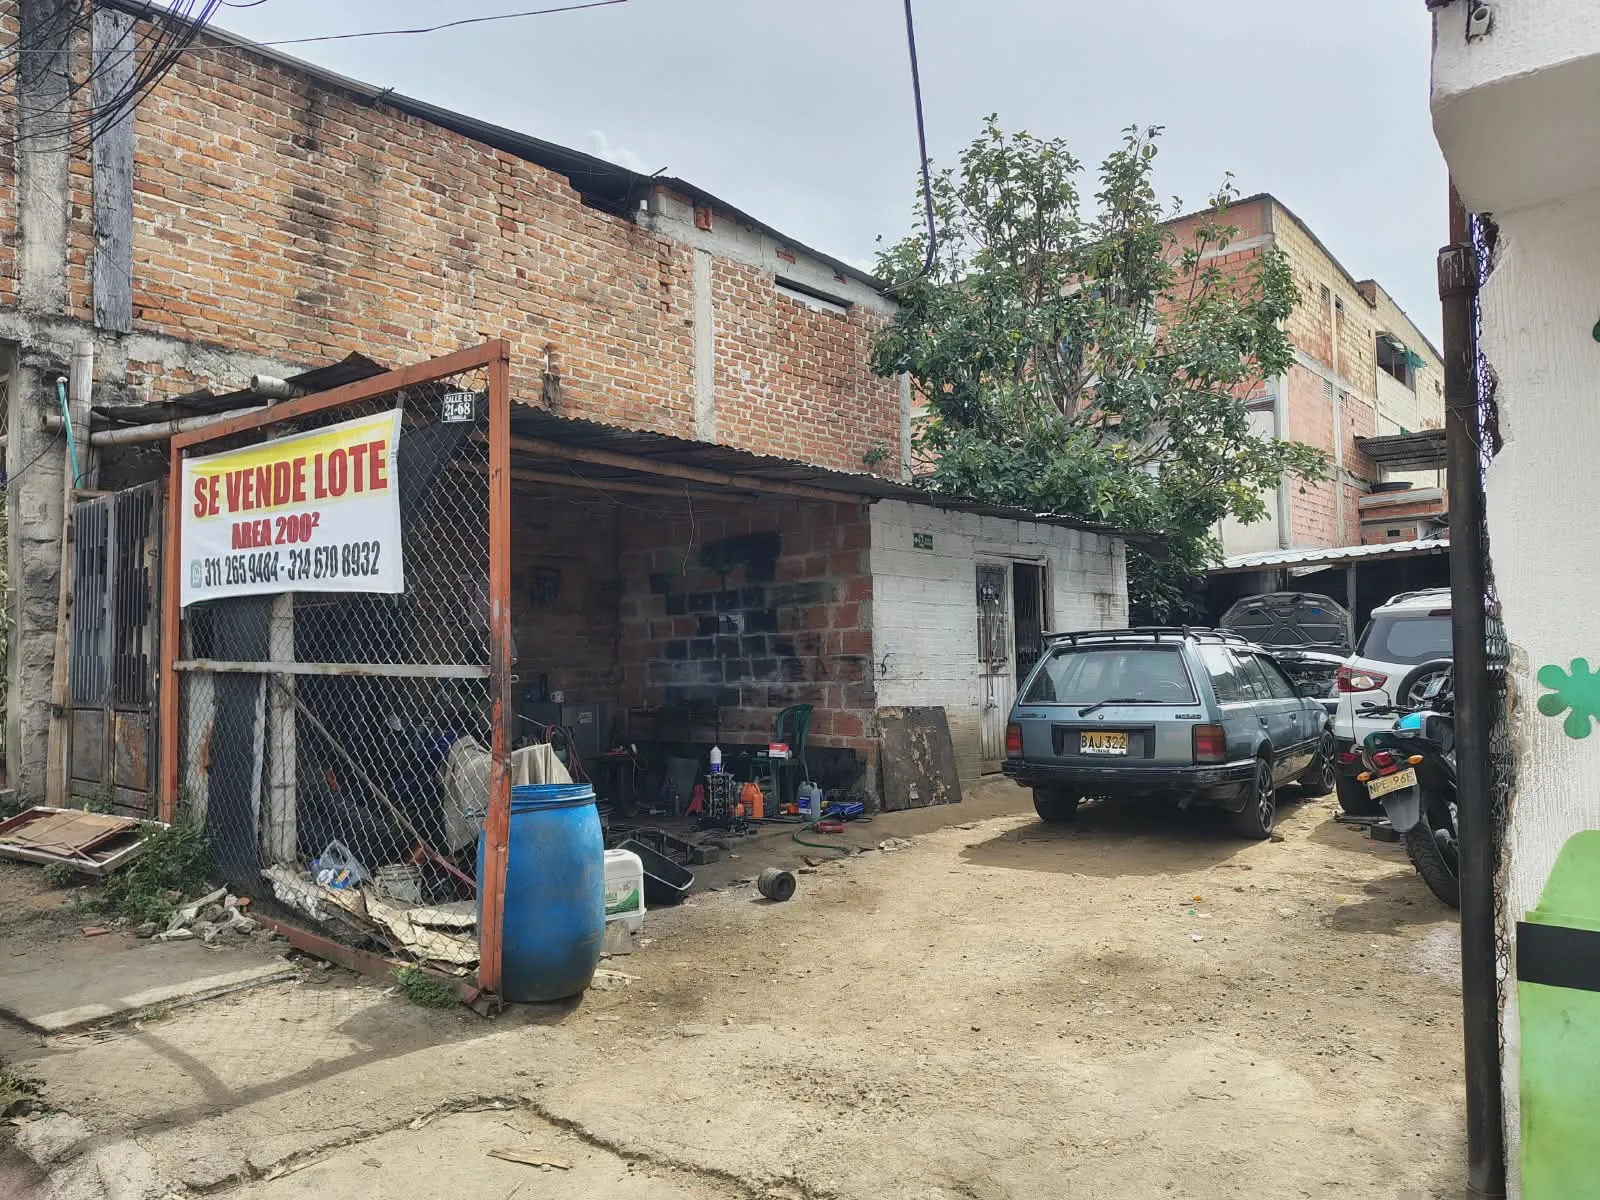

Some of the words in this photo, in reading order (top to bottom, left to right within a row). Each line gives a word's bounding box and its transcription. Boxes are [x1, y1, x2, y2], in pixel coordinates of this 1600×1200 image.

[444, 402, 471, 417] 21-68
[193, 474, 220, 518] SE
[225, 457, 307, 513] VENDE
[314, 440, 388, 499] LOTE
[231, 518, 272, 550] AREA
[204, 557, 222, 587] 311
[225, 554, 247, 585] 265
[249, 551, 279, 583] 9484
[287, 548, 311, 581] 314
[314, 545, 339, 579] 670
[341, 540, 381, 577] 8932
[1081, 735, 1102, 748] BAJ
[1105, 735, 1126, 749] 322
